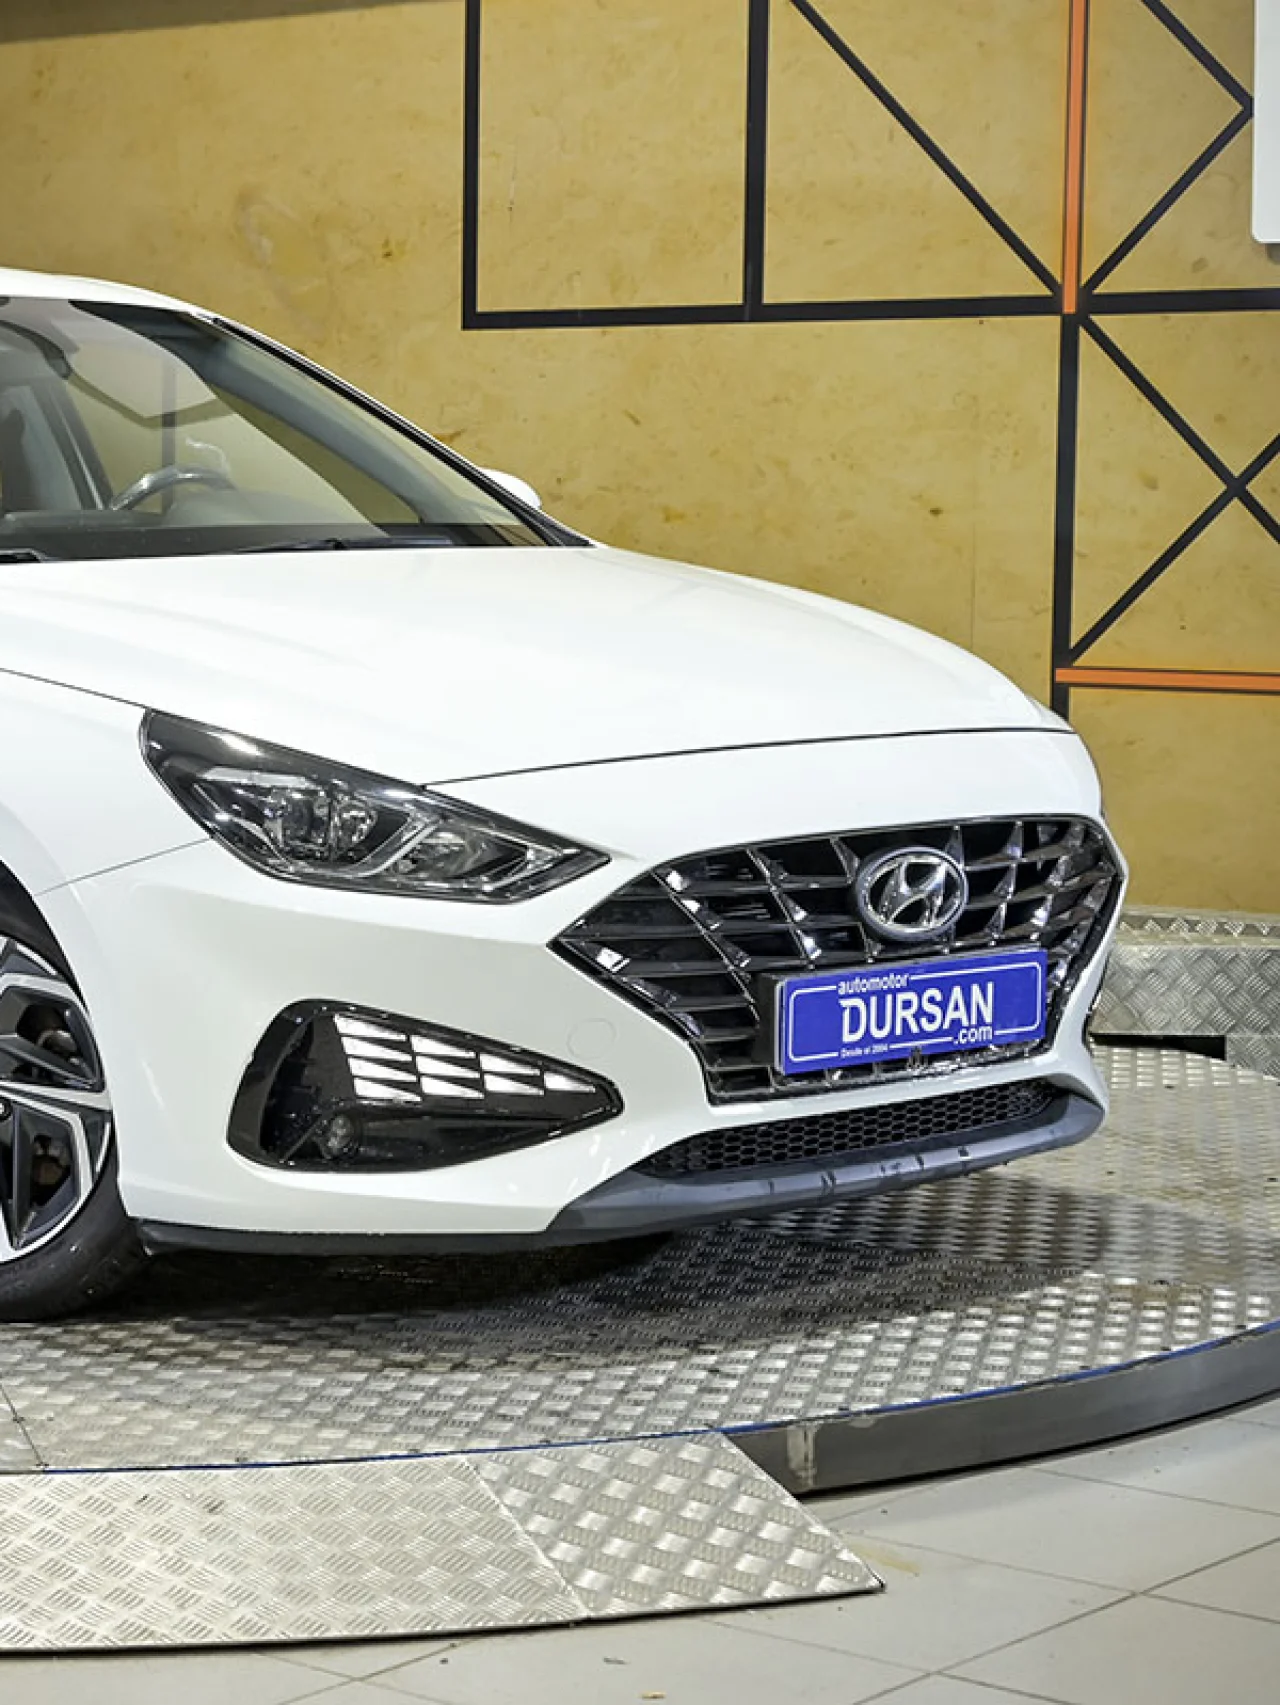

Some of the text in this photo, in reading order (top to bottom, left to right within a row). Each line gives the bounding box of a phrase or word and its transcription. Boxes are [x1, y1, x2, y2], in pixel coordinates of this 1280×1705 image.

[838, 972, 910, 995] automotor
[839, 981, 995, 1043] DURSAN
[953, 1025, 993, 1045] .com
